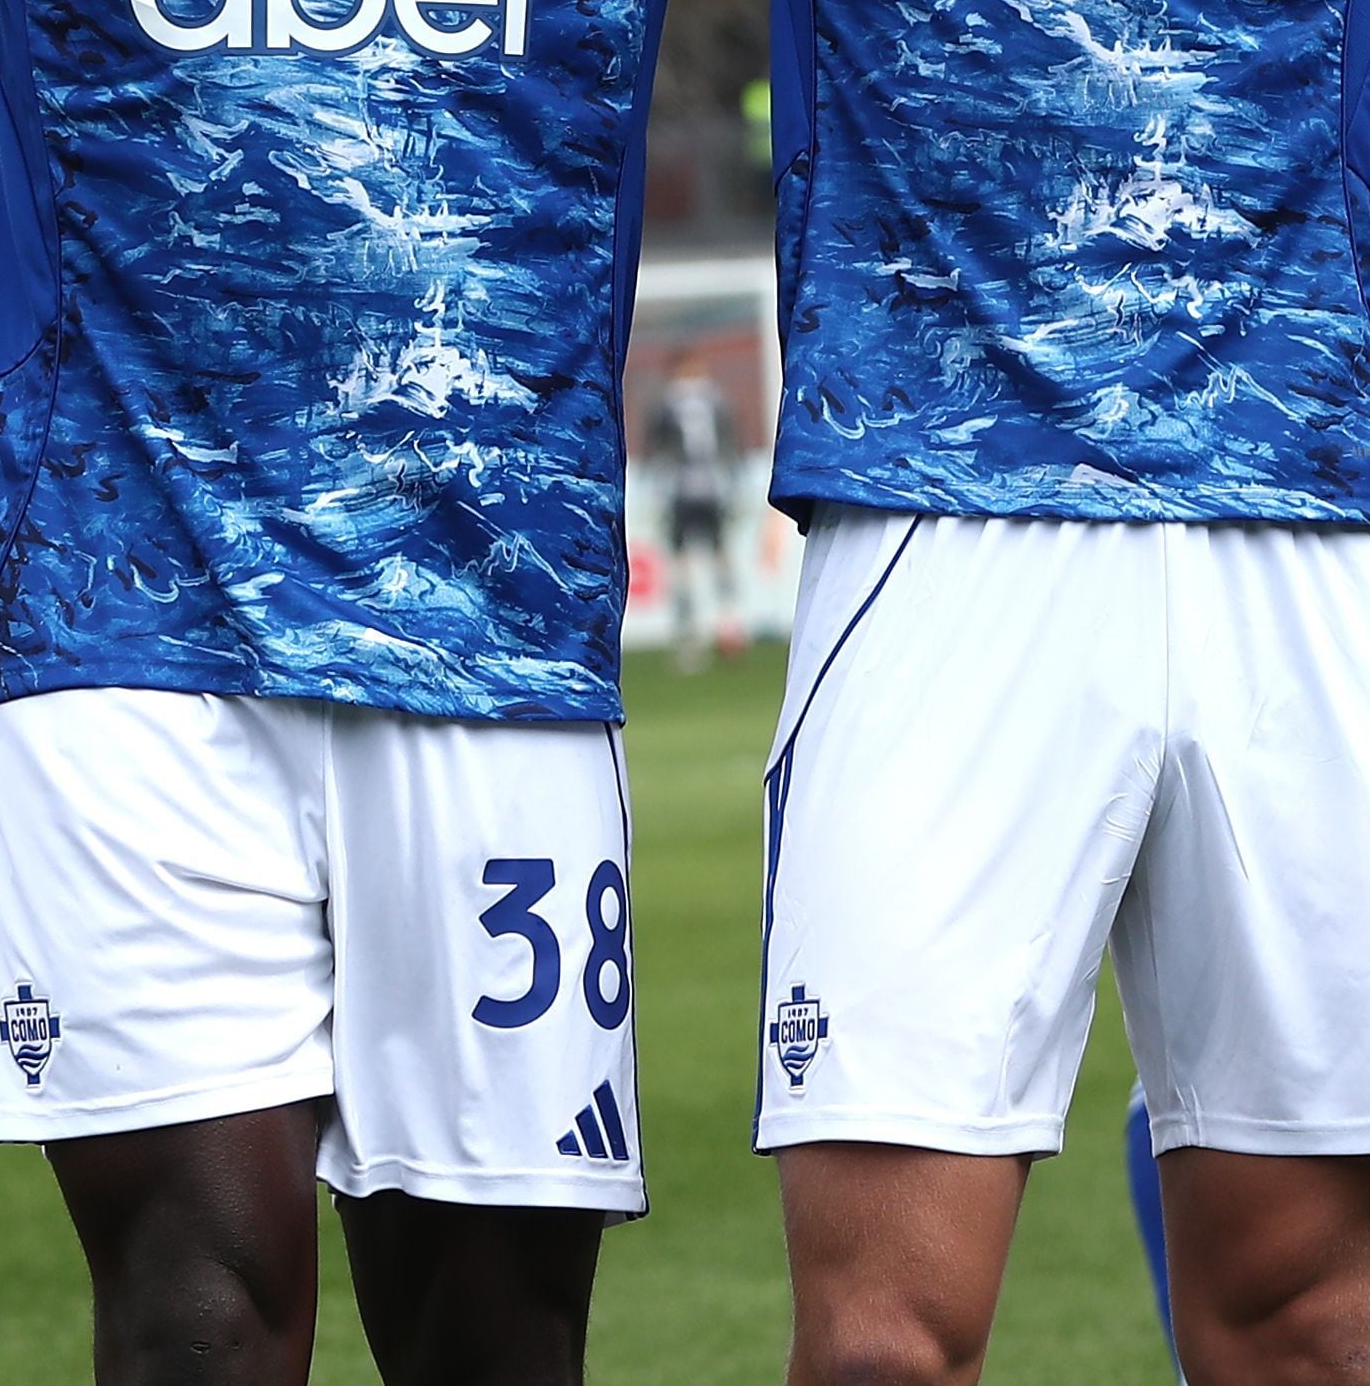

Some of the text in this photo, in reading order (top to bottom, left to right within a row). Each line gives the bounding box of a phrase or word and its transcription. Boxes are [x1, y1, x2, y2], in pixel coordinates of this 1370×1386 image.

[472, 858, 630, 1030] 38
[11, 1018, 47, 1042] COMO
[781, 1019, 815, 1044] COMO
